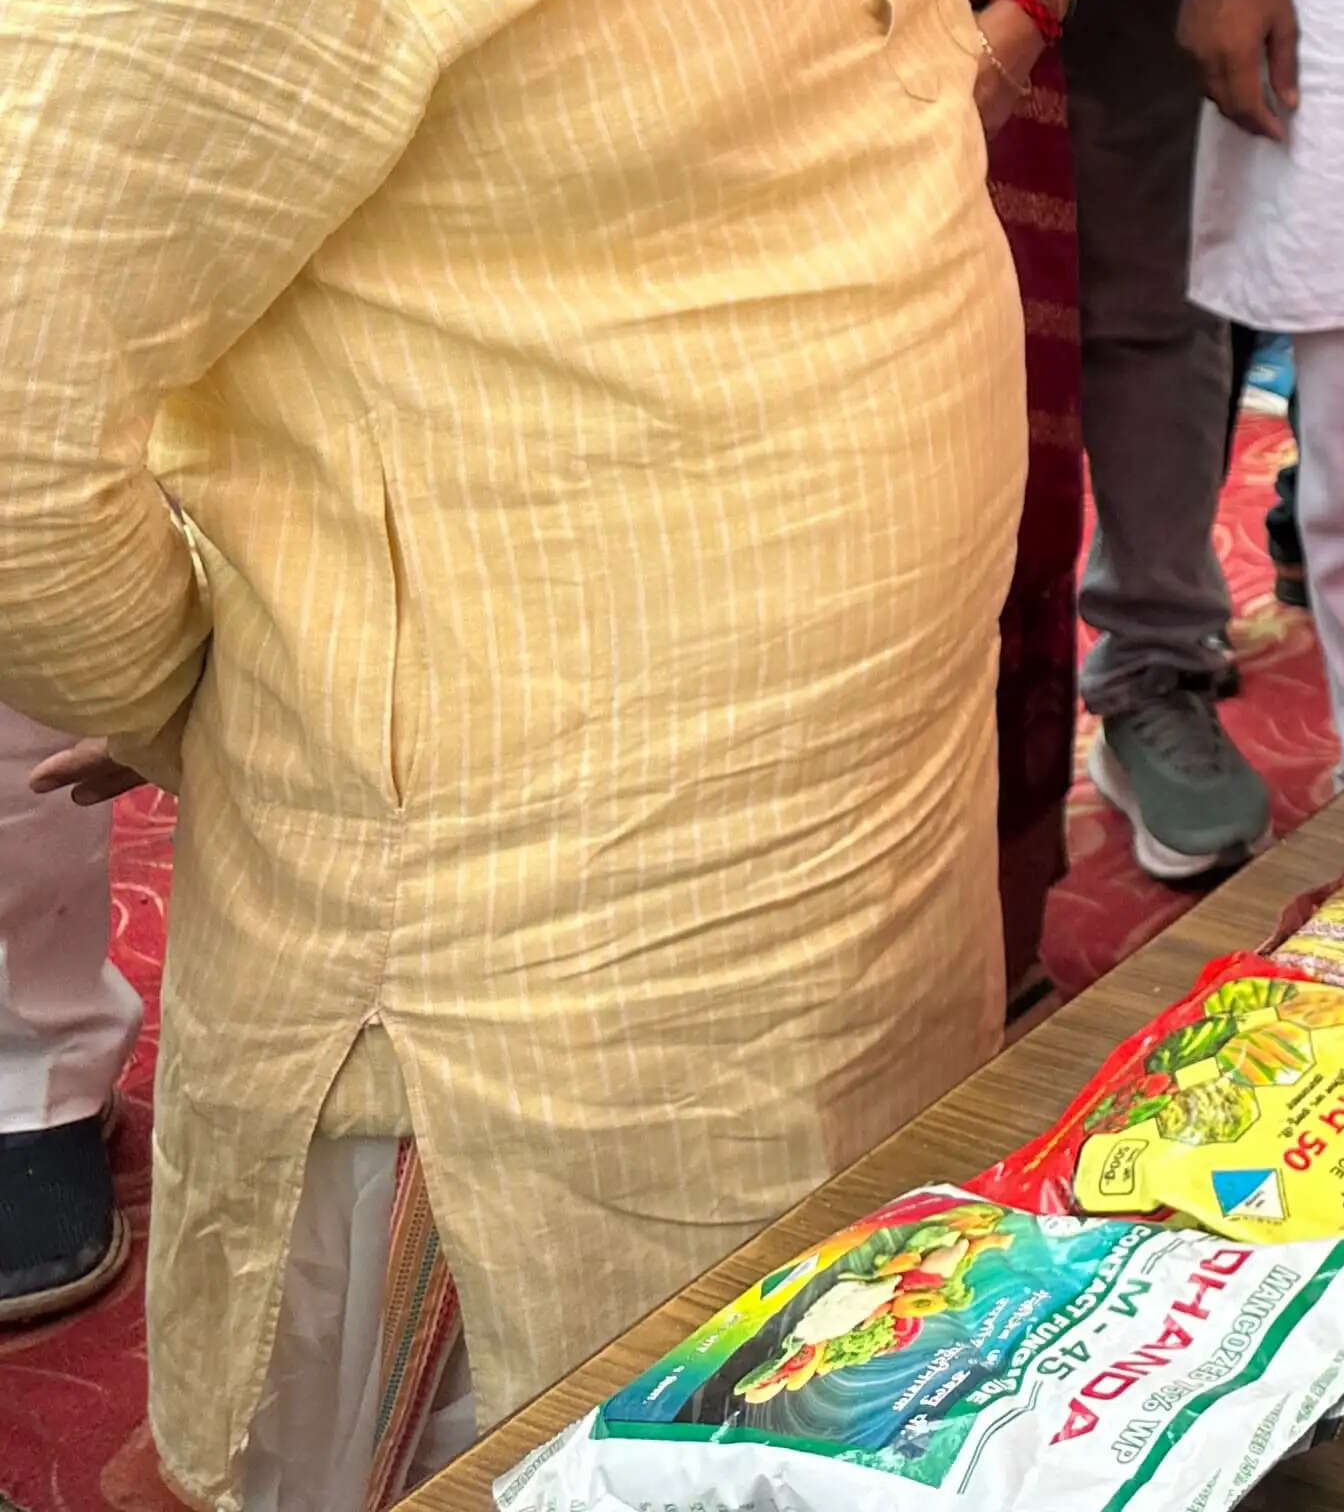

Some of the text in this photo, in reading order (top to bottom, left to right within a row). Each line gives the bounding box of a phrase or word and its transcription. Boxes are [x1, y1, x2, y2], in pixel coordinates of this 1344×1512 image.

[1284, 1130, 1326, 1170] 50
[1066, 1223, 1149, 1318] CONTACT
[1108, 1278, 1151, 1316] M
[1038, 1342, 1090, 1381] 45
[1050, 1251, 1252, 1444] DHANDA
[1114, 1418, 1156, 1463] WP
